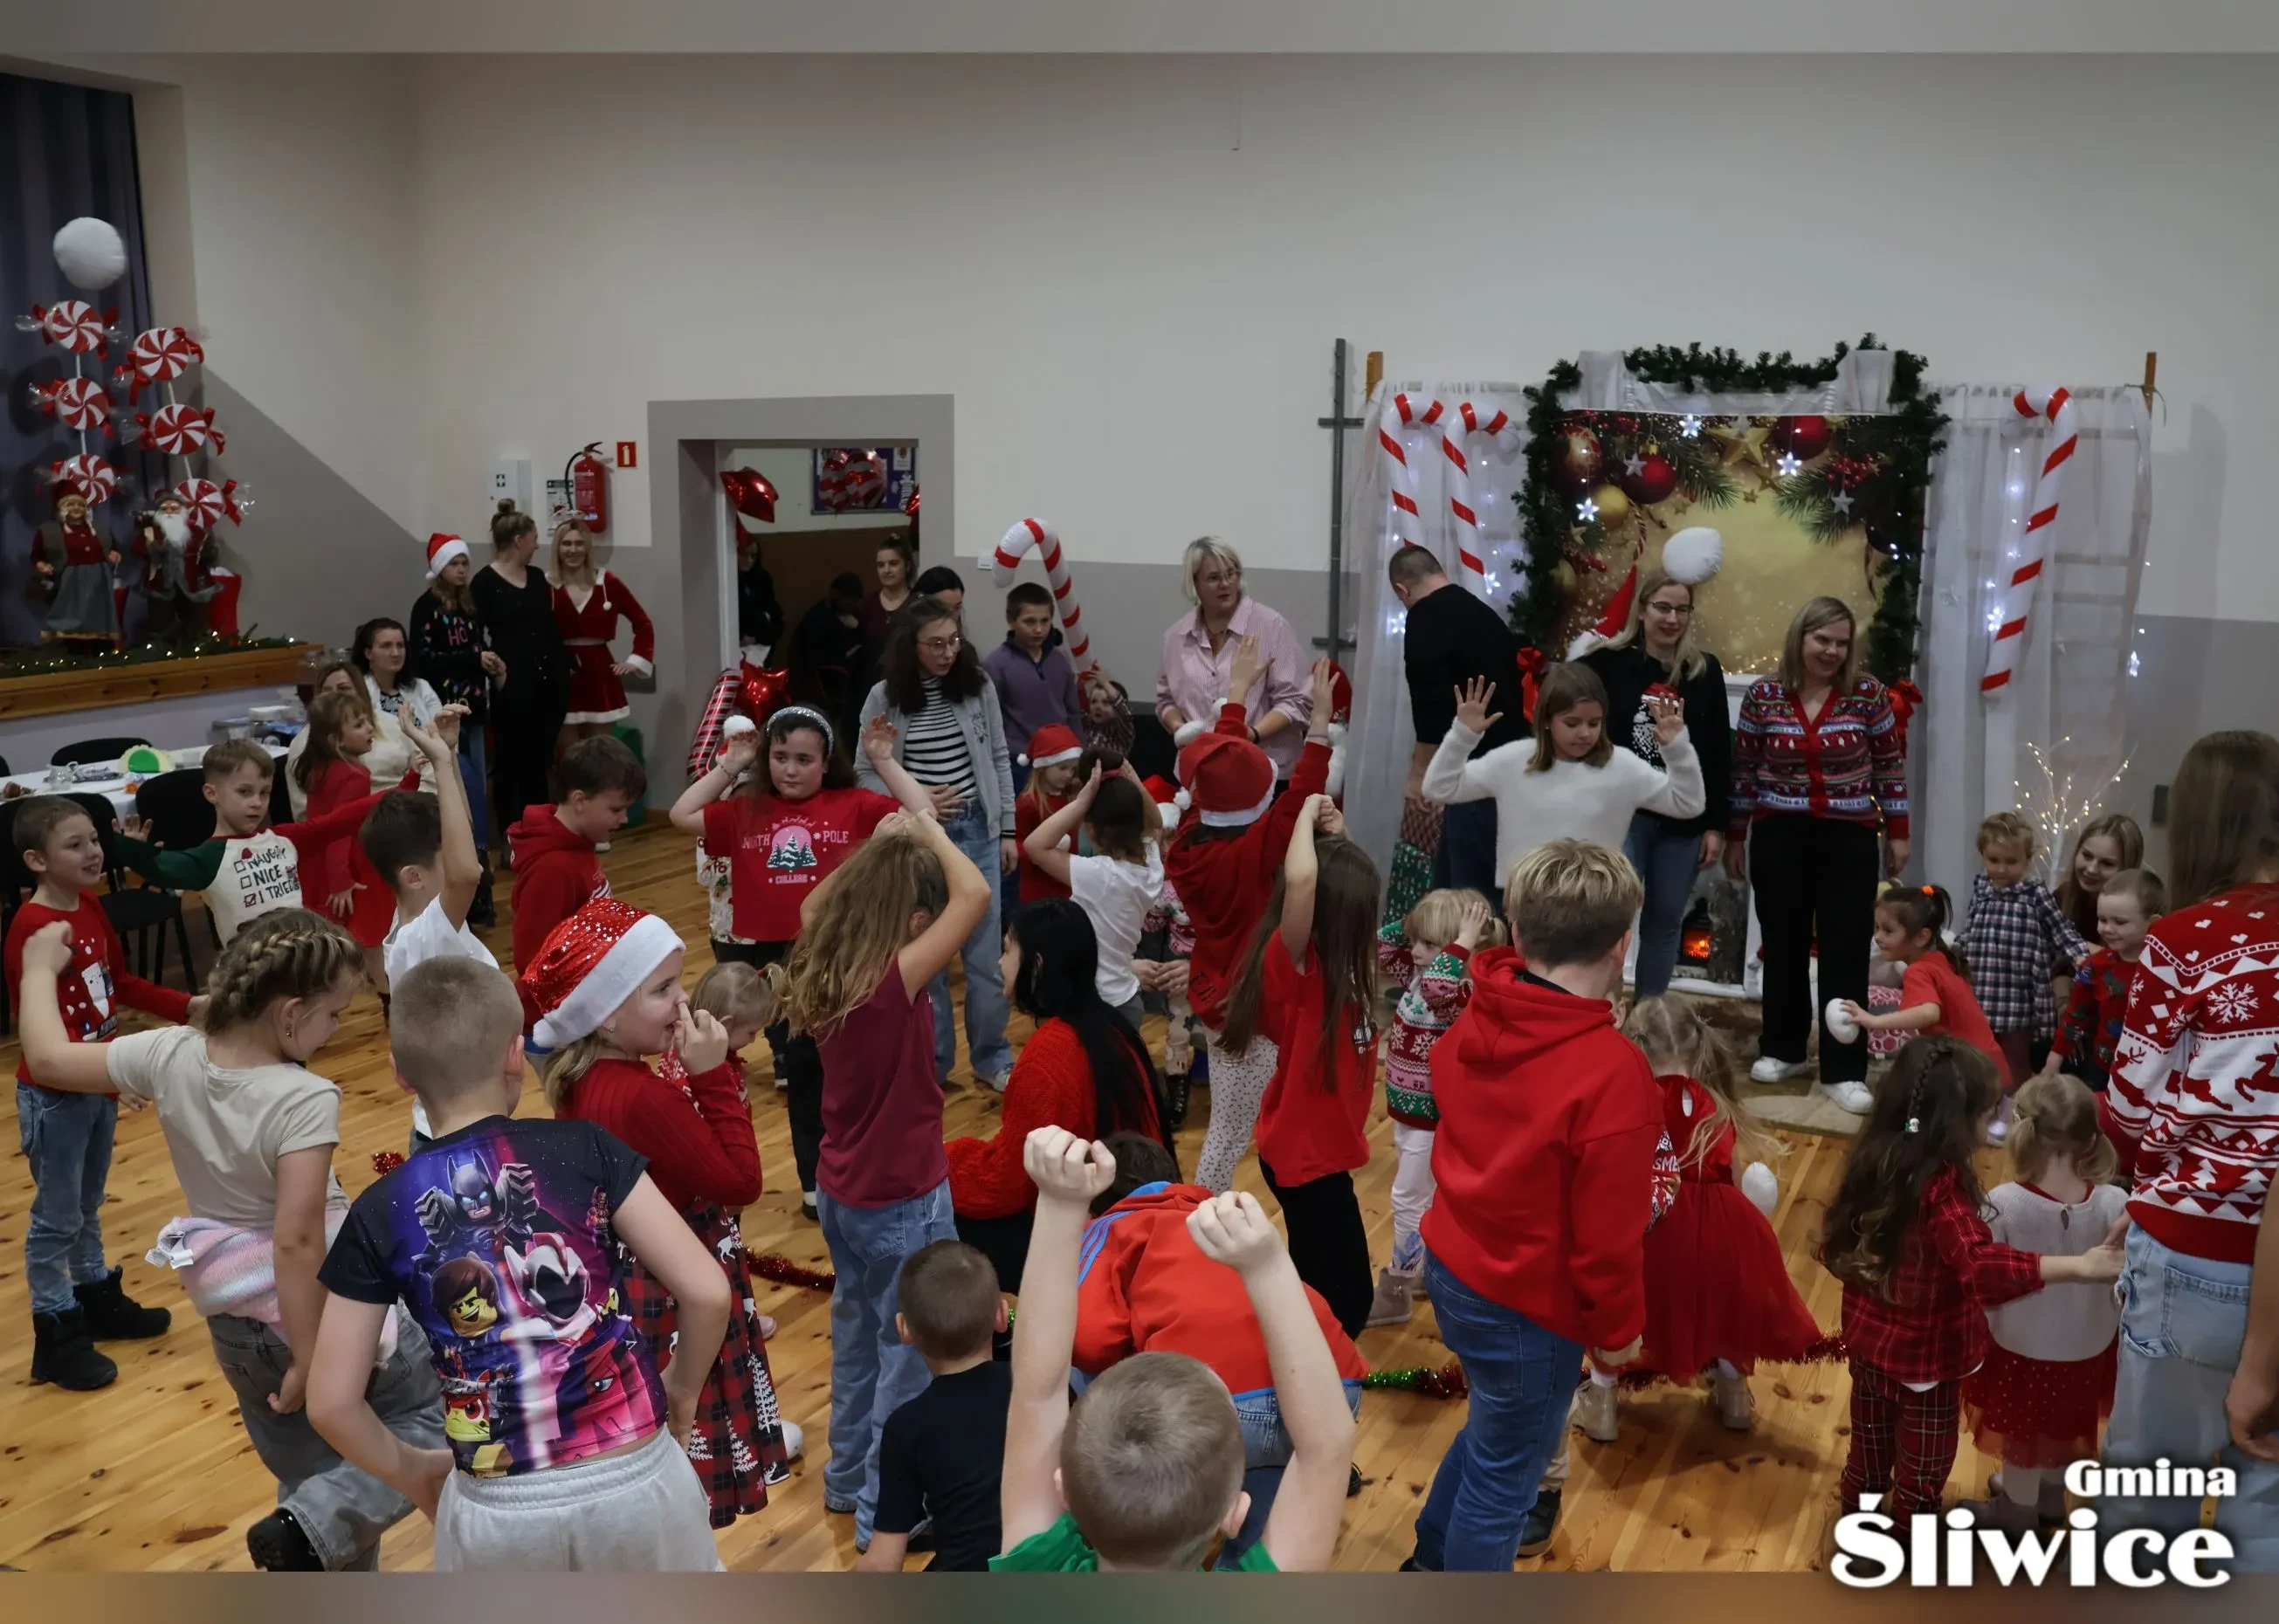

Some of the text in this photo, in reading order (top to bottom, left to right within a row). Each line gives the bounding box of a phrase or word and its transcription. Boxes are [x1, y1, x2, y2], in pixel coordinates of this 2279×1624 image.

[823, 830, 849, 843] POLE
[252, 864, 282, 886] NICE
[258, 891, 265, 904] I
